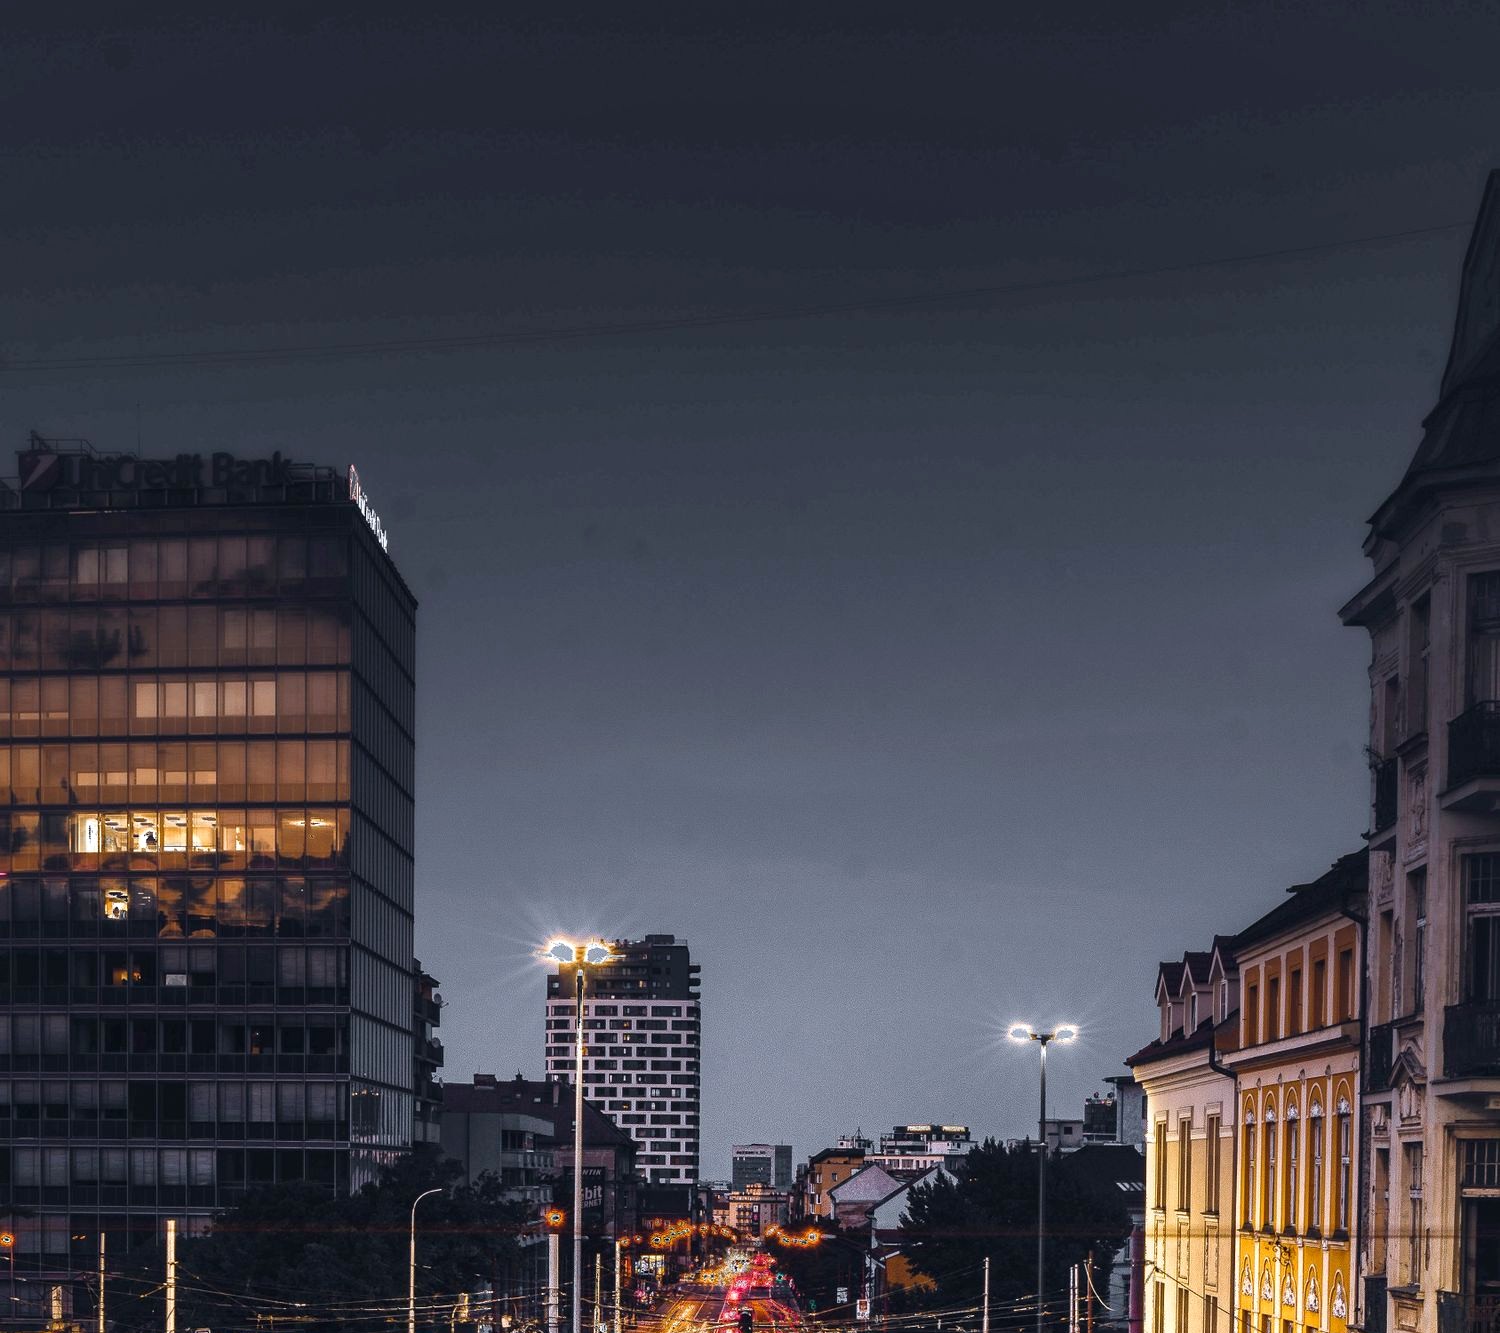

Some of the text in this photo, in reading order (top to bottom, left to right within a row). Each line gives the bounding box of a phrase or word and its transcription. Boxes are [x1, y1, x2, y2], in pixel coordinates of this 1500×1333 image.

[64, 450, 293, 488] UniCredit Bank
[582, 1185, 603, 1200] bit
